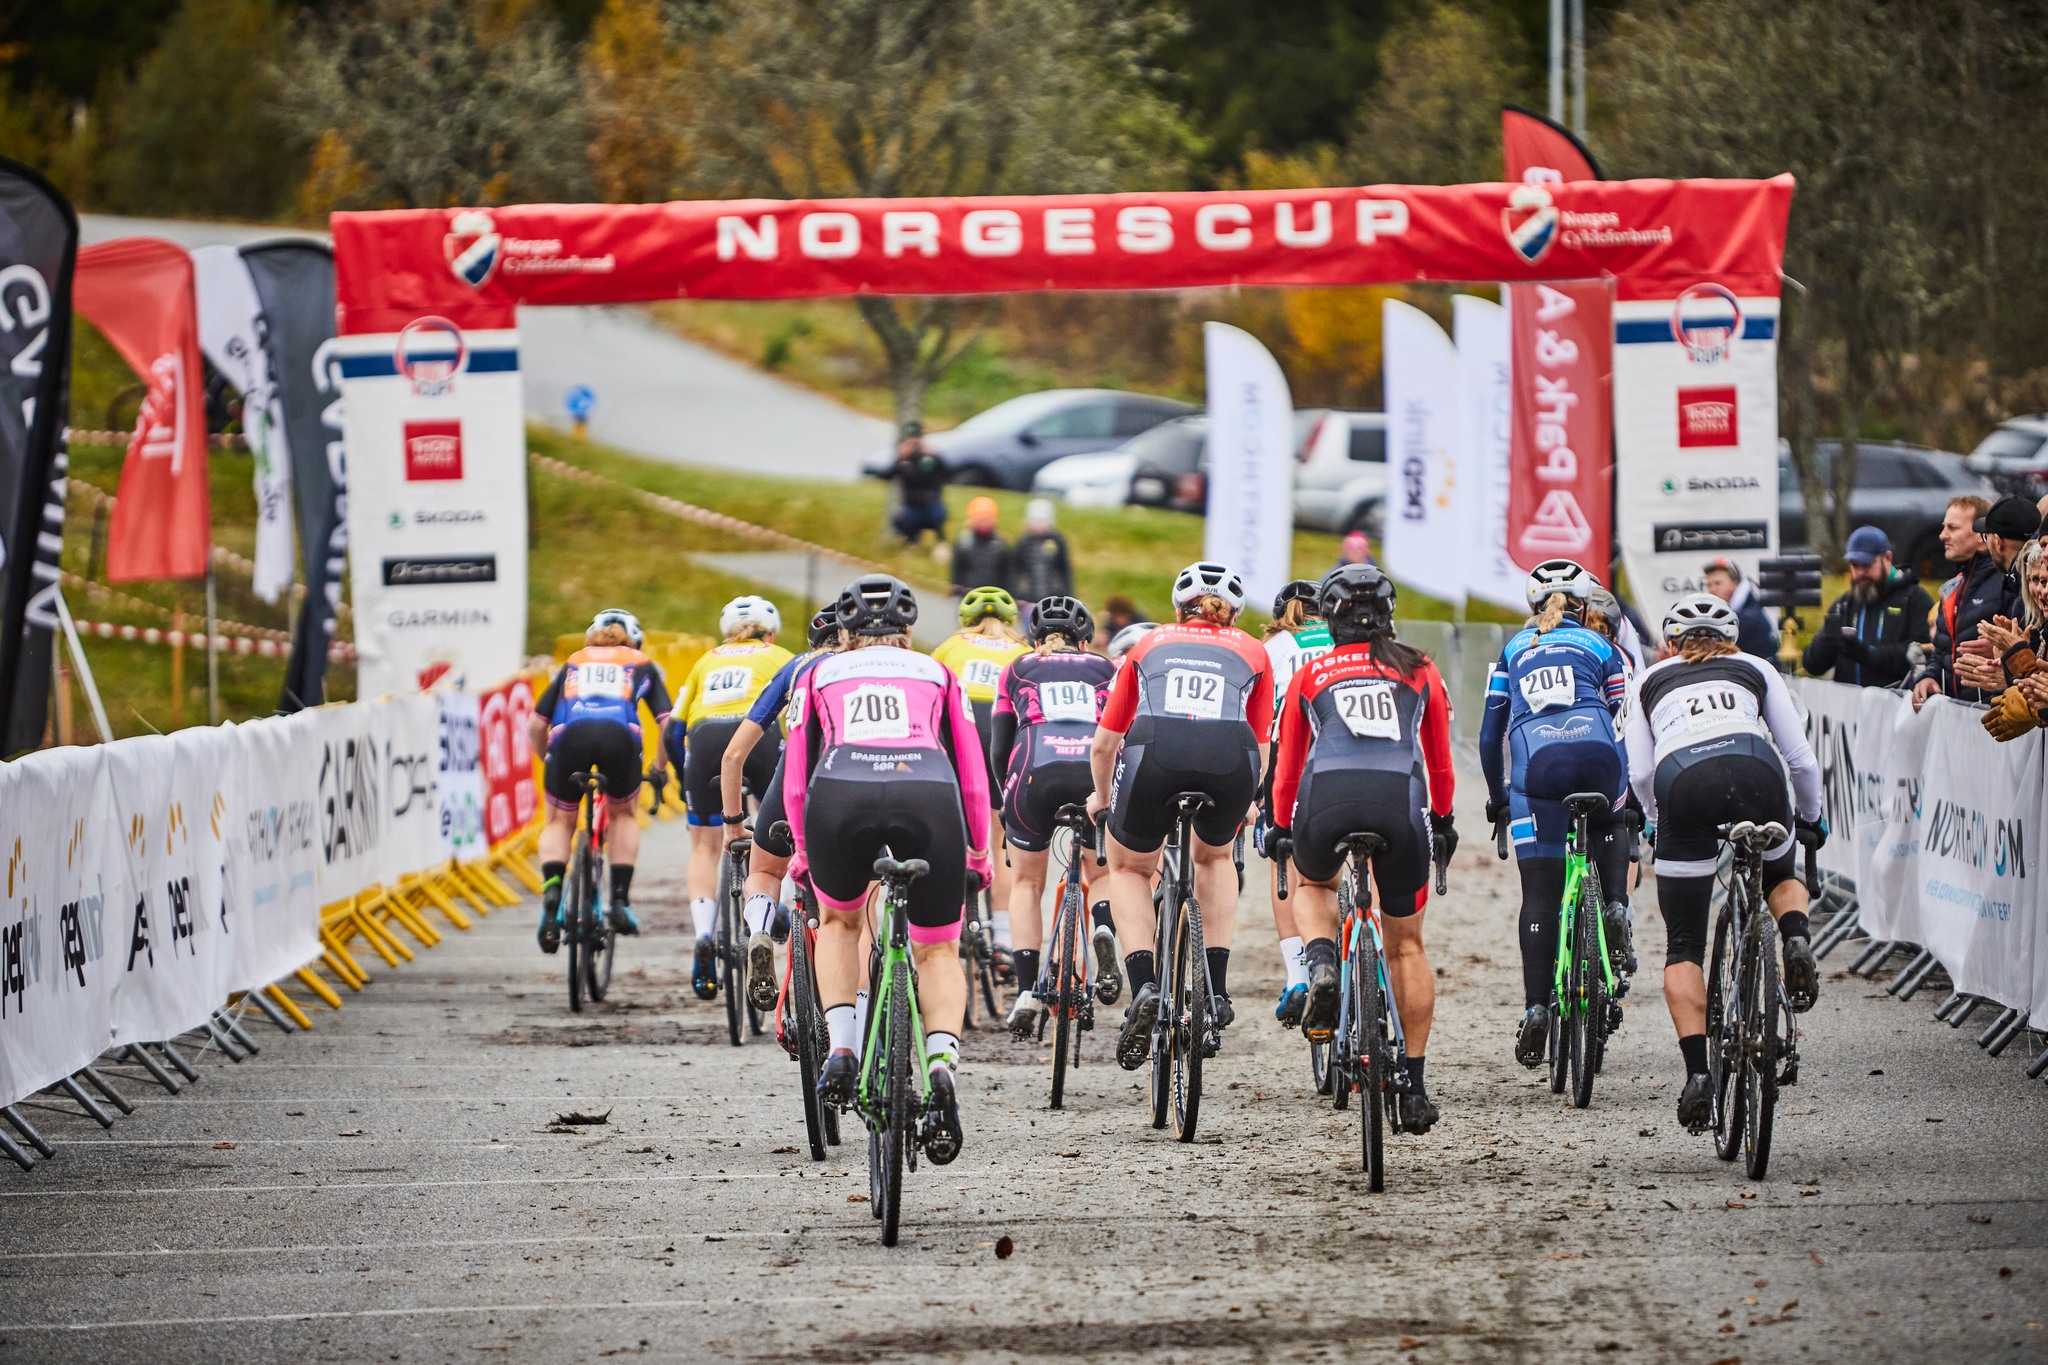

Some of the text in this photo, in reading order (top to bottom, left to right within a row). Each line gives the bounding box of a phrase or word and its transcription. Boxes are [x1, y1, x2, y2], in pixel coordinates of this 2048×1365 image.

[716, 200, 1410, 260] NORGESCUP
[585, 665, 617, 683] 198
[1165, 657, 1222, 669] POWERADE
[709, 670, 746, 691] 202
[1174, 674, 1218, 702] 192
[1525, 665, 1569, 695] 204
[1047, 684, 1090, 706] 194
[1342, 691, 1393, 721] 206
[1686, 691, 1736, 717] 210
[850, 694, 900, 724] 208
[850, 751, 922, 762] SPAREBANKEN
[873, 762, 895, 771] SØR
